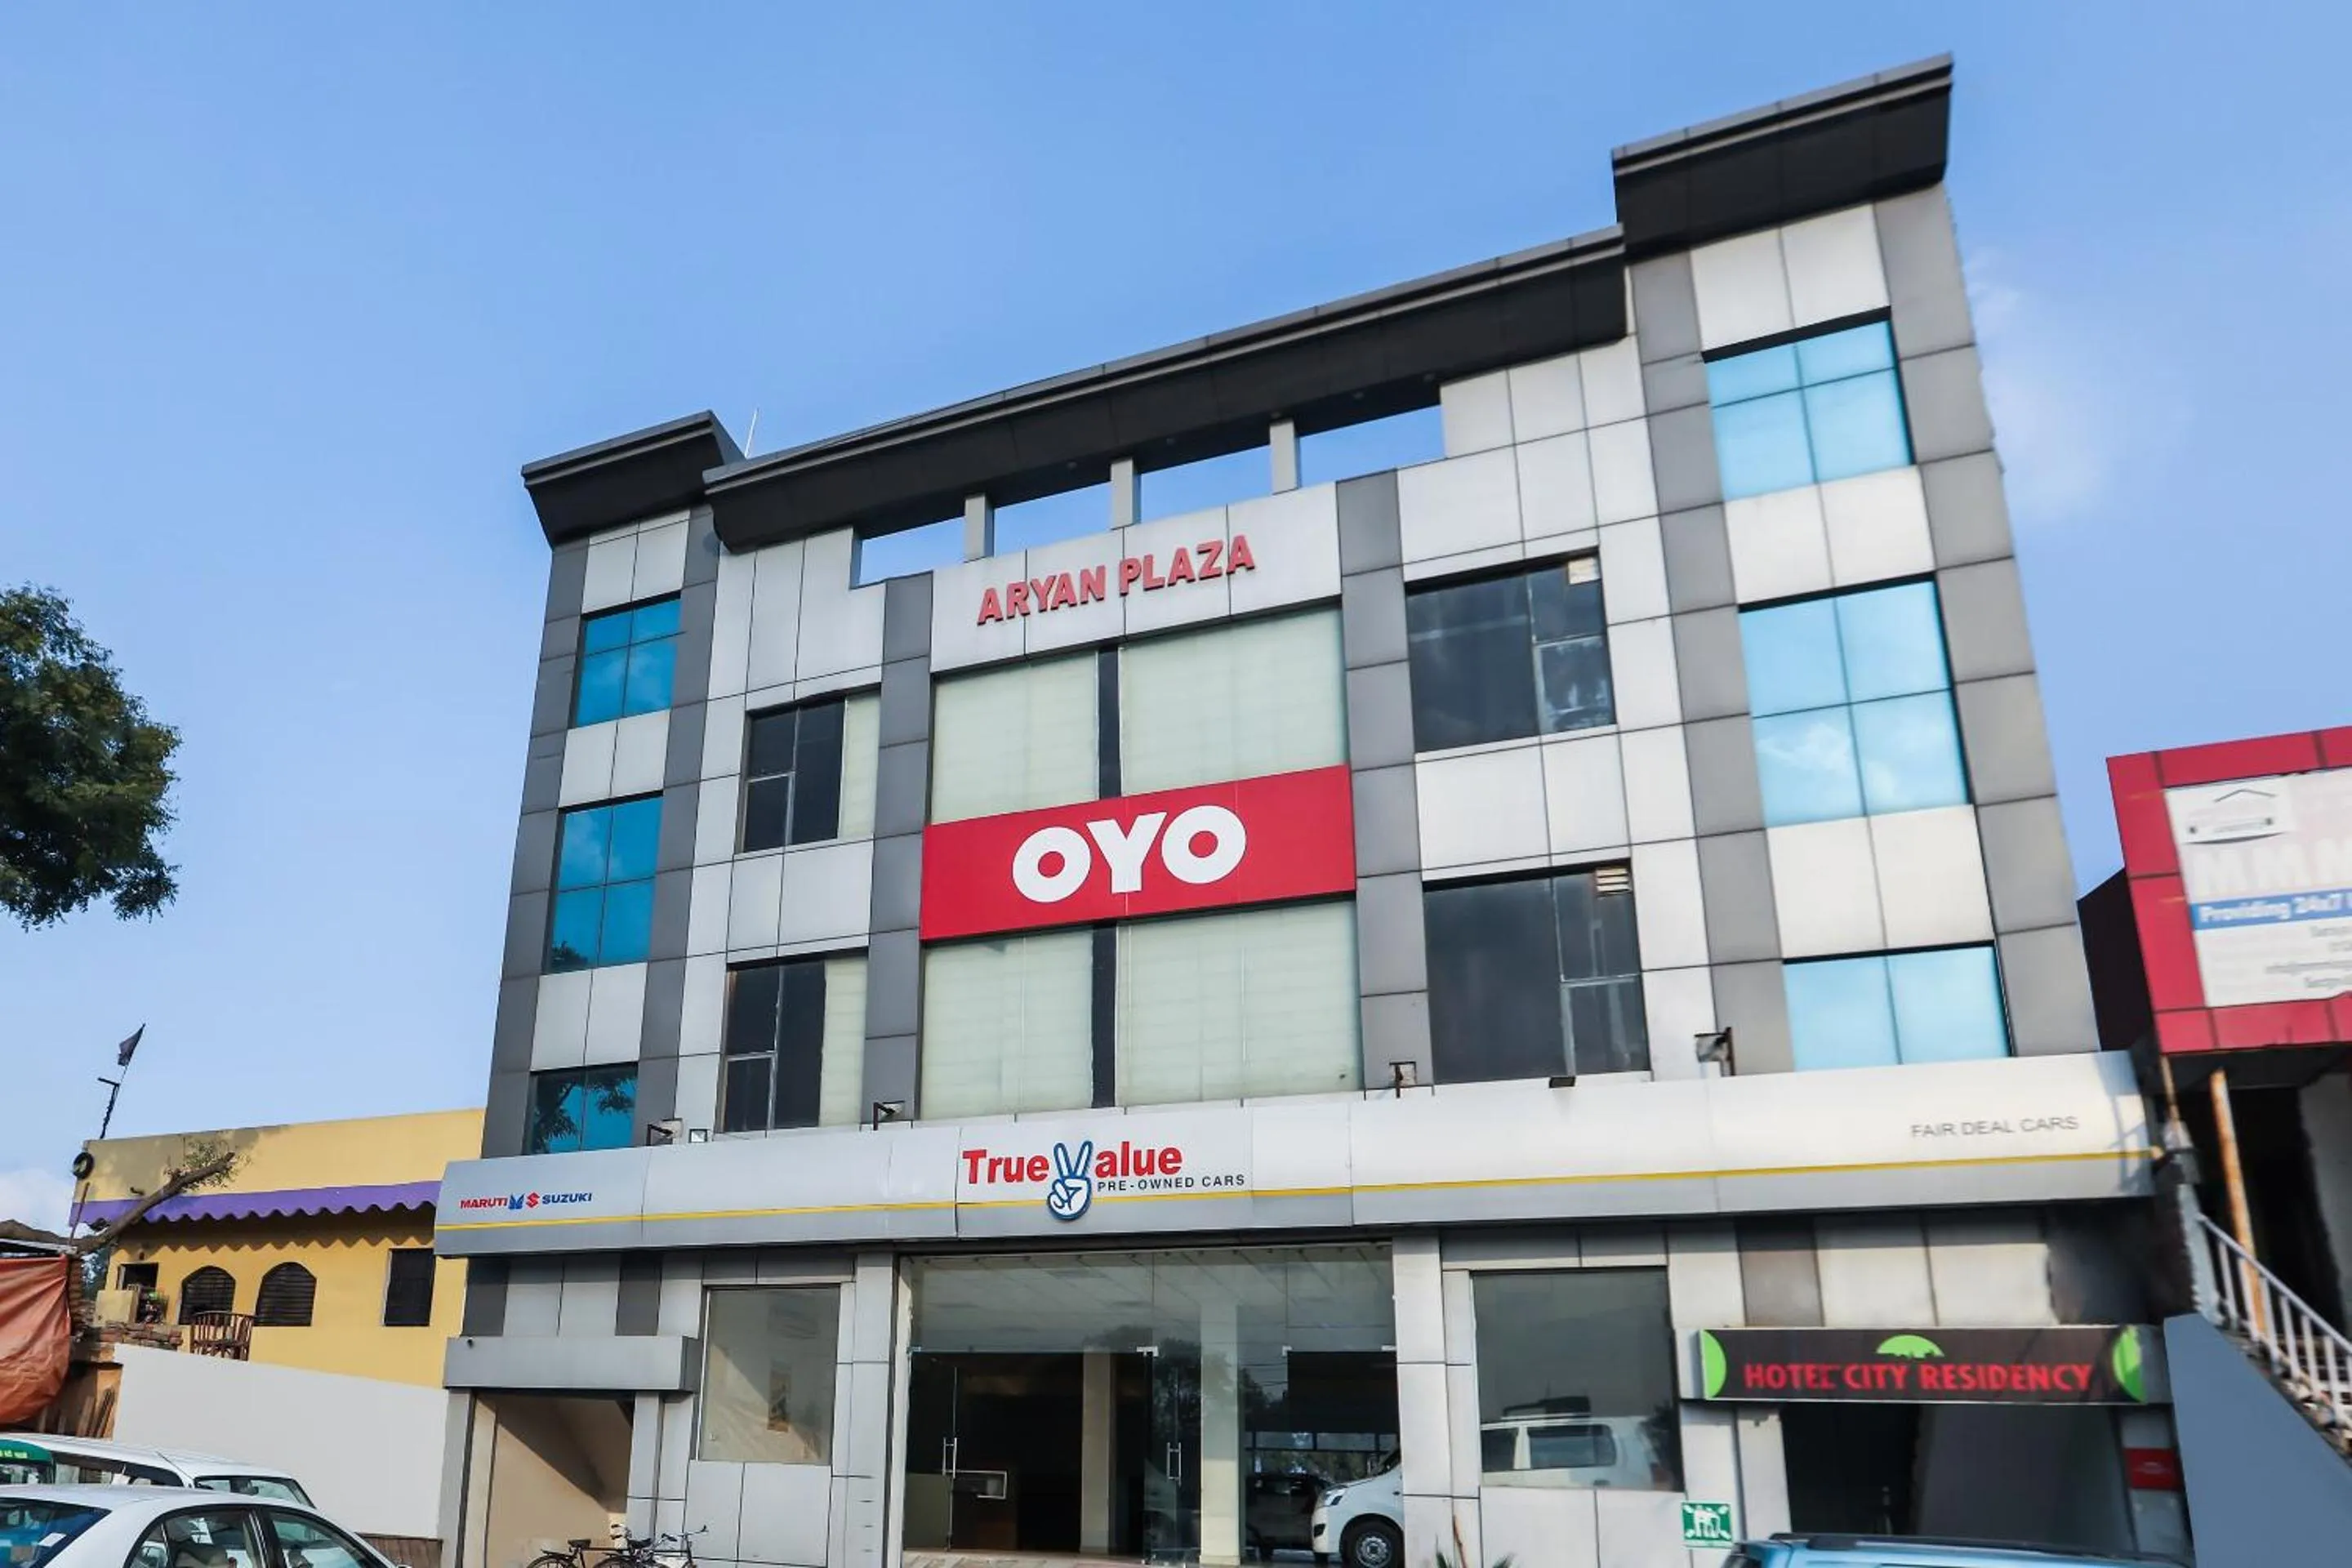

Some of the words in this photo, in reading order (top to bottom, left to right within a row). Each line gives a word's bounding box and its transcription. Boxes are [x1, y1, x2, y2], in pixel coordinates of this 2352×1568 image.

[978, 565, 1107, 626] ARYAN
[1119, 535, 1255, 597] PLAZA
[1012, 804, 1246, 903] OYO
[1910, 1123, 1958, 1138] FAIR
[1960, 1120, 2015, 1136] DEAL
[2020, 1116, 2079, 1133] CARS
[962, 1149, 1050, 1184] True
[1098, 1176, 1195, 1192] PRE-OWNED
[1201, 1174, 1245, 1188] CARS
[460, 1197, 509, 1209] MARUTI
[541, 1192, 593, 1205] SUZUKI
[1842, 1363, 1908, 1390] CITY
[1919, 1363, 2093, 1392] RESIDENCY
